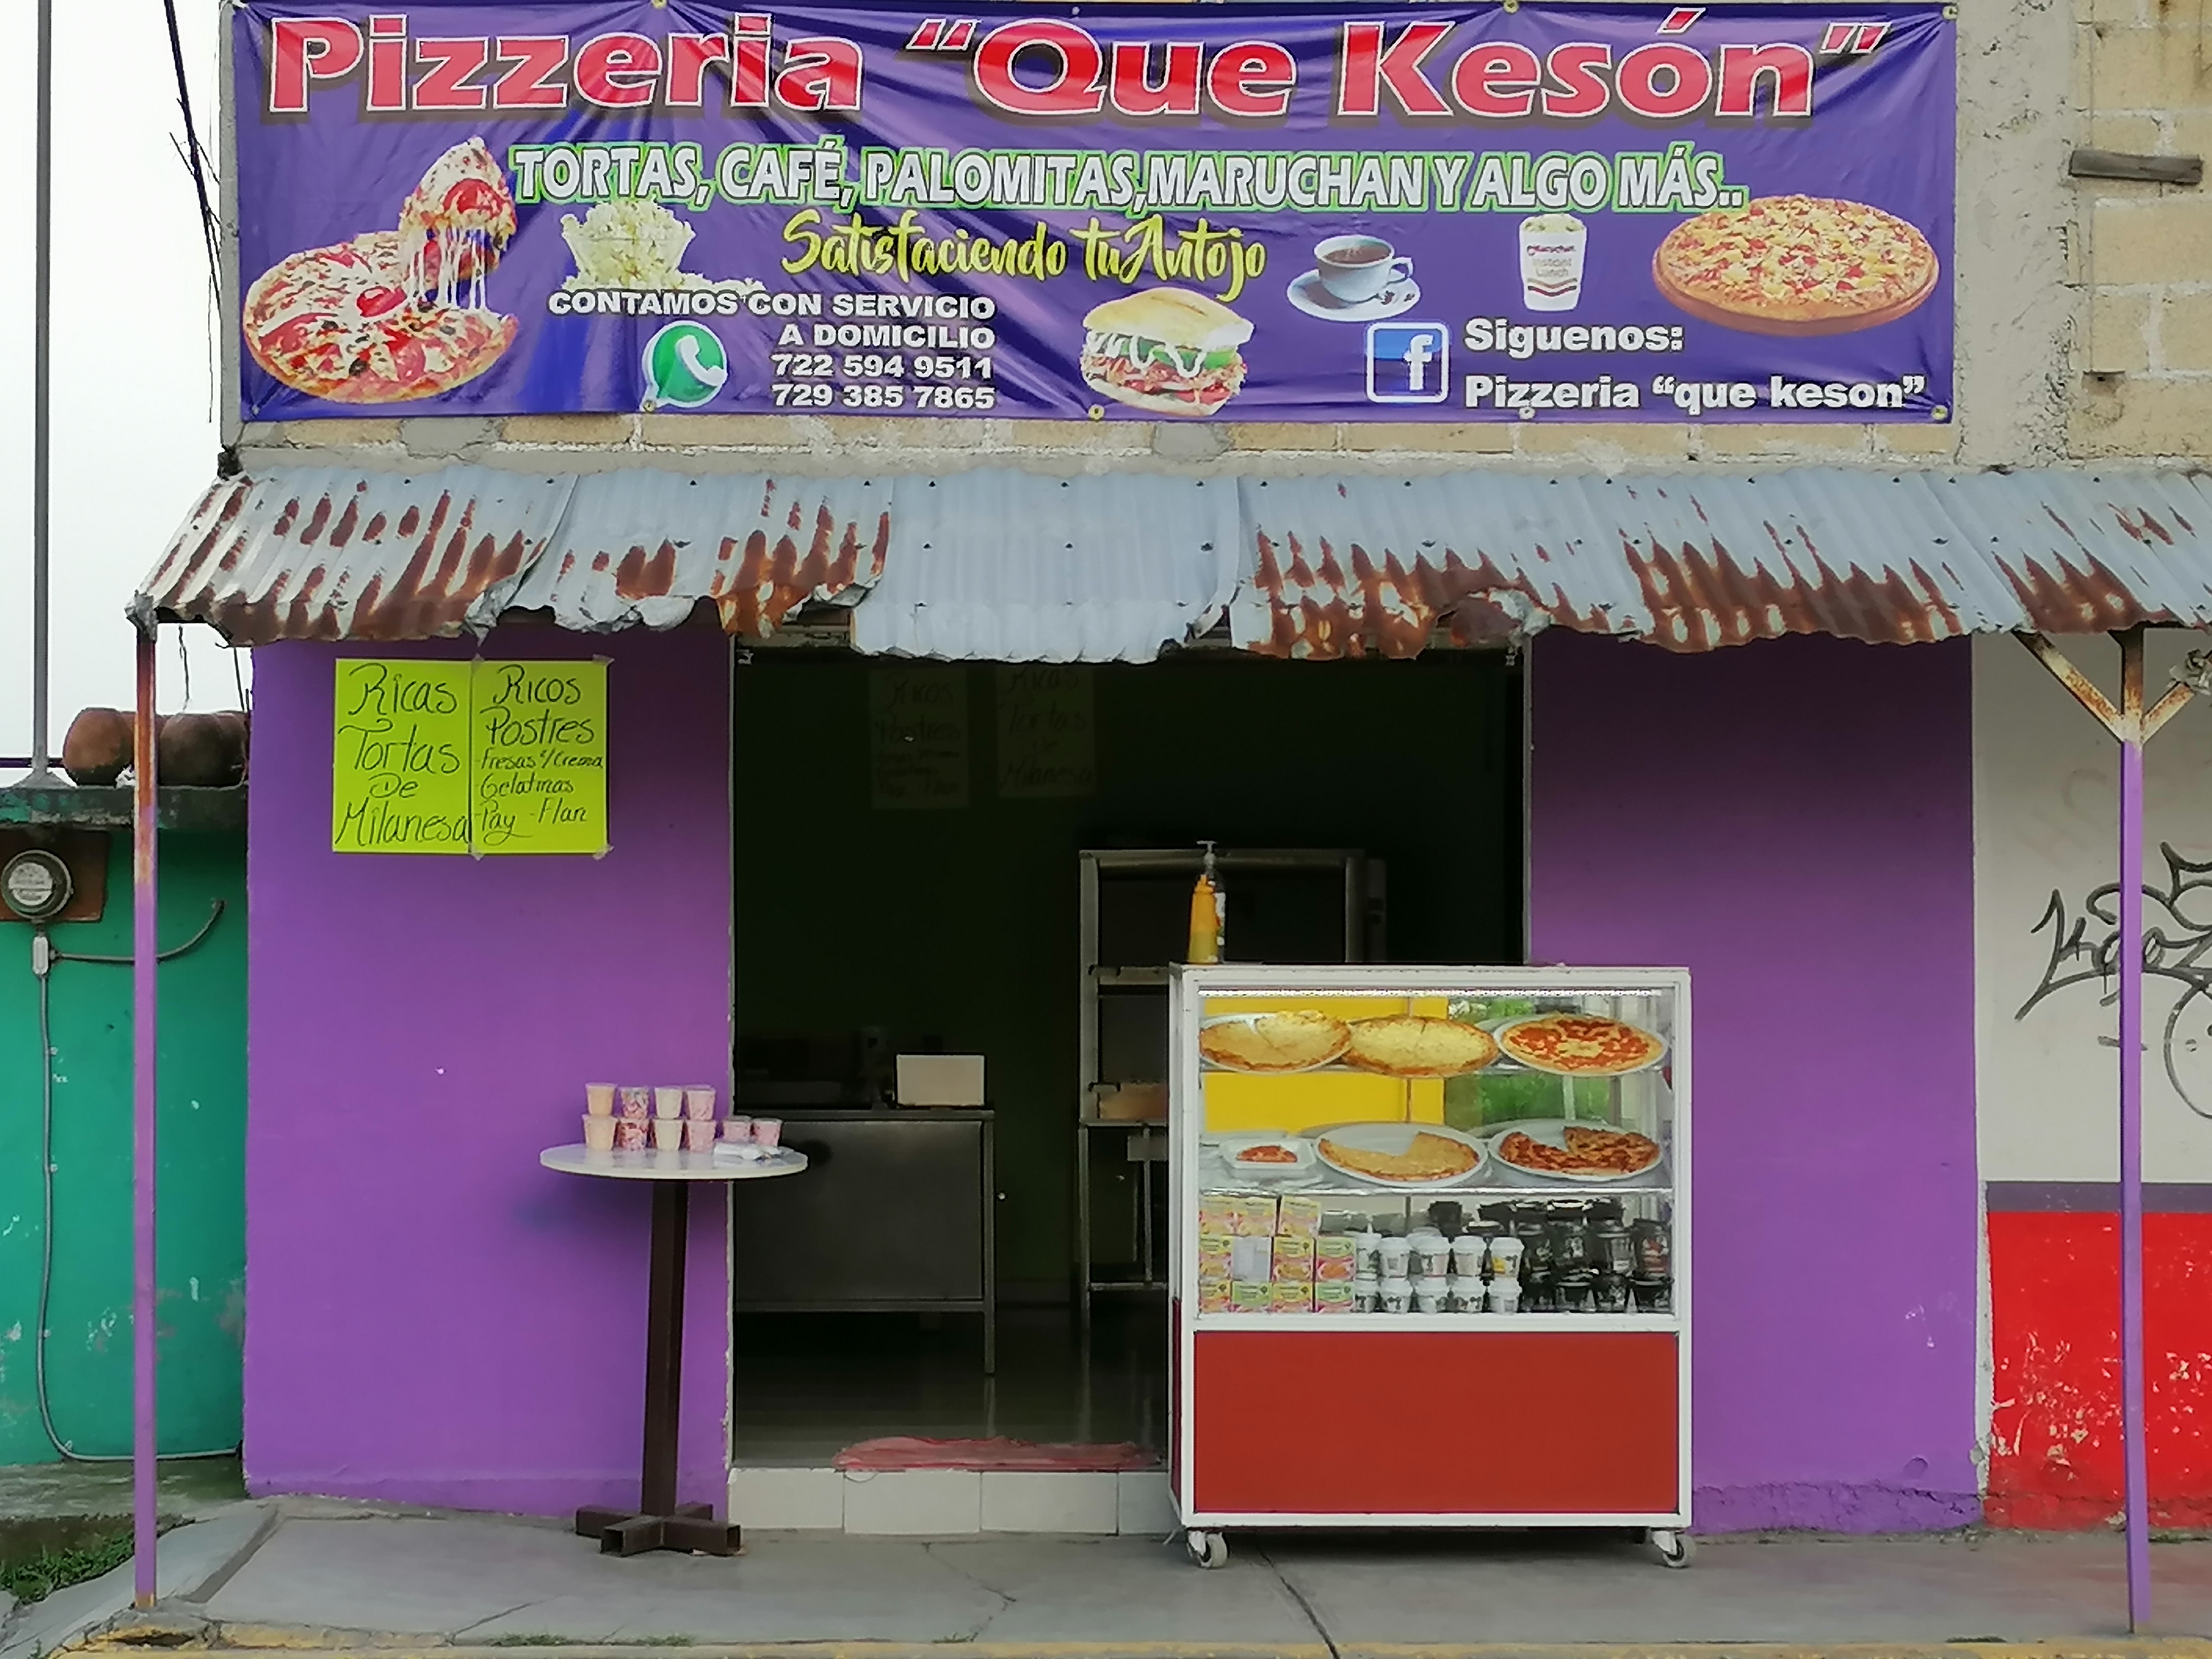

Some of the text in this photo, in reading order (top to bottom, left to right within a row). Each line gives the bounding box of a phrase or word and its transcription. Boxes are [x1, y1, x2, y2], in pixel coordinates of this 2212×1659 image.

[269, 12, 863, 112] Pizzeria
[513, 146, 713, 207] TORTAS,
[720, 138, 854, 208] CAFÉ,
[1431, 155, 1470, 208] Y
[1470, 154, 1609, 209] ALGO
[782, 209, 1067, 283] Satisfaciendo
[549, 290, 995, 319] CONTAMOS CON SERVICIO
[779, 325, 996, 349] A DOMICILIO
[1463, 317, 1684, 358] Siguenos:
[773, 354, 993, 379] 722 594 9511
[772, 384, 995, 410] 729 385 7865
[1464, 374, 1640, 409] Pizzeria
[348, 662, 457, 716] Ricas
[493, 664, 581, 705] Ricos
[338, 718, 460, 774] Tortas
[480, 705, 594, 747] Postres
[368, 773, 418, 798] De
[335, 797, 469, 846] Milanesa
